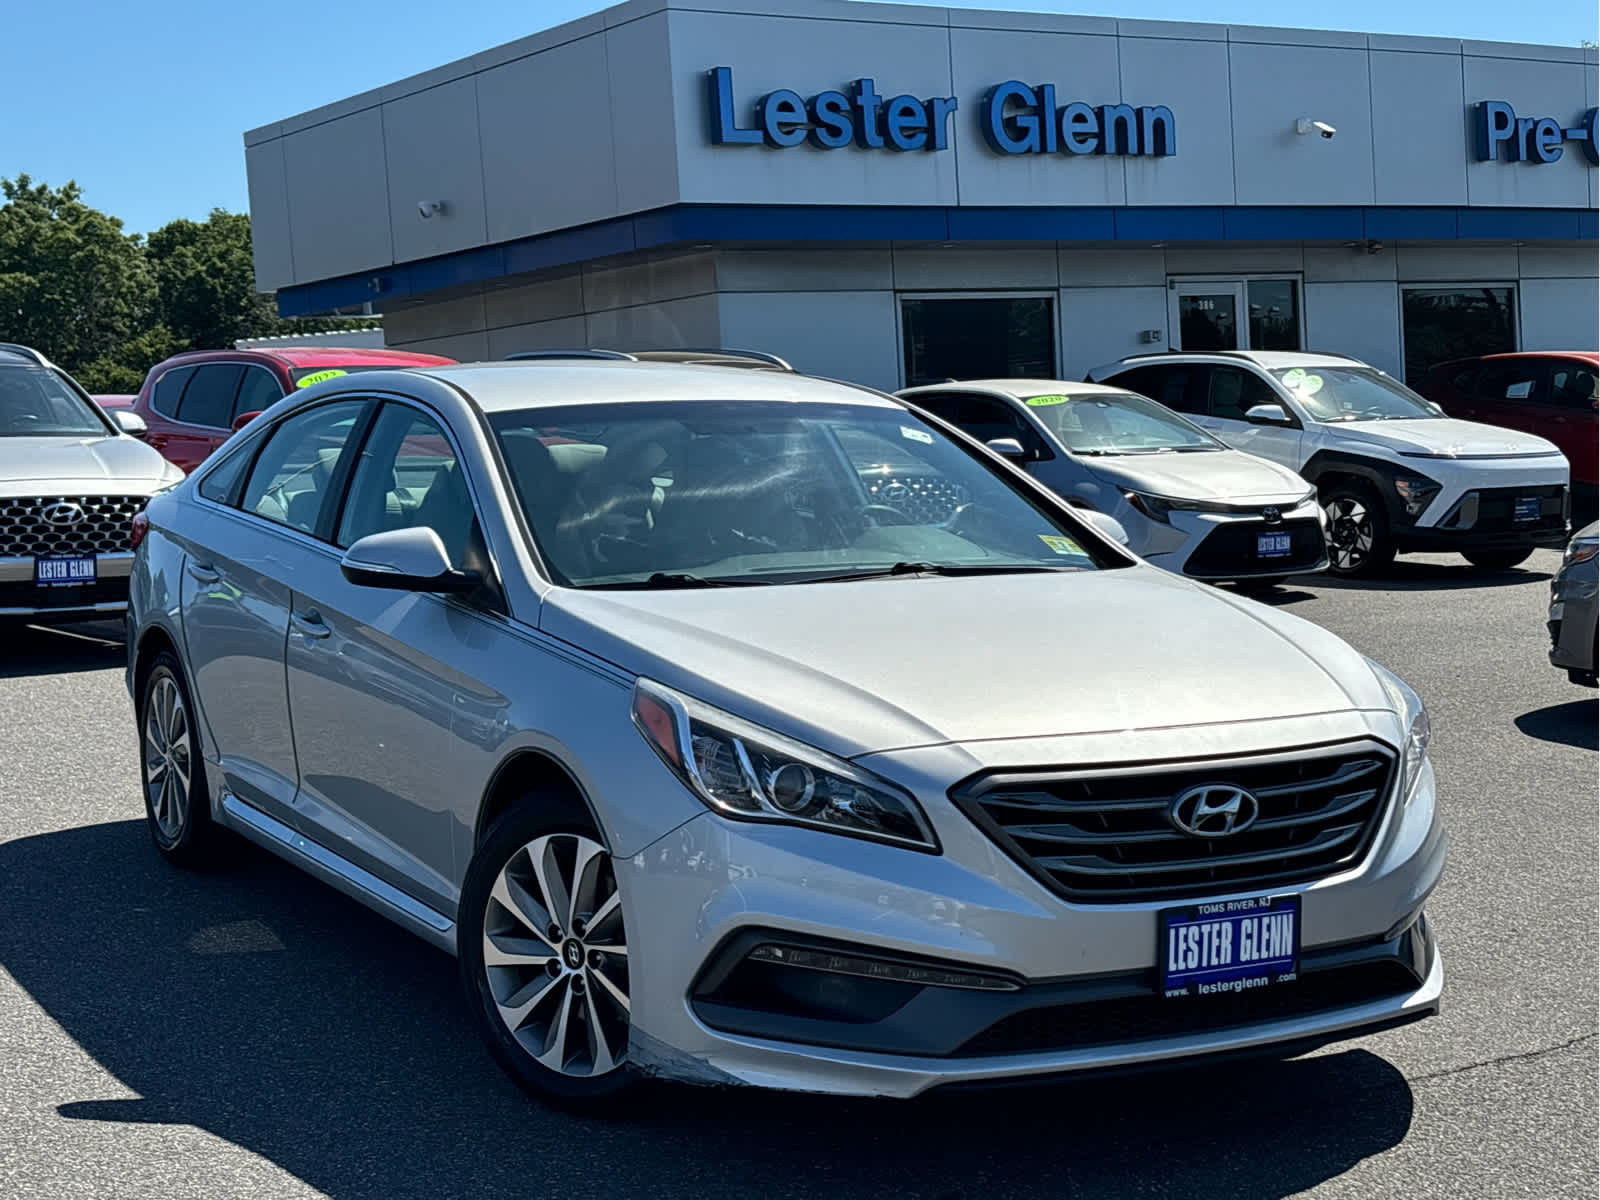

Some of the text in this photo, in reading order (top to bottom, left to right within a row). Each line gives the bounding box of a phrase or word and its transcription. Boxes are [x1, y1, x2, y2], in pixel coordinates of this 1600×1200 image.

[711, 66, 1177, 157] Lester Glenn
[1480, 99, 1599, 168] Pre-
[38, 559, 95, 579] LESTER GLENN
[1198, 903, 1225, 915] TOMS
[1259, 897, 1272, 907] NJ
[1168, 913, 1294, 972] LESTER GLENN
[1198, 976, 1269, 995] lesterglenn
[1275, 972, 1297, 983] .com
